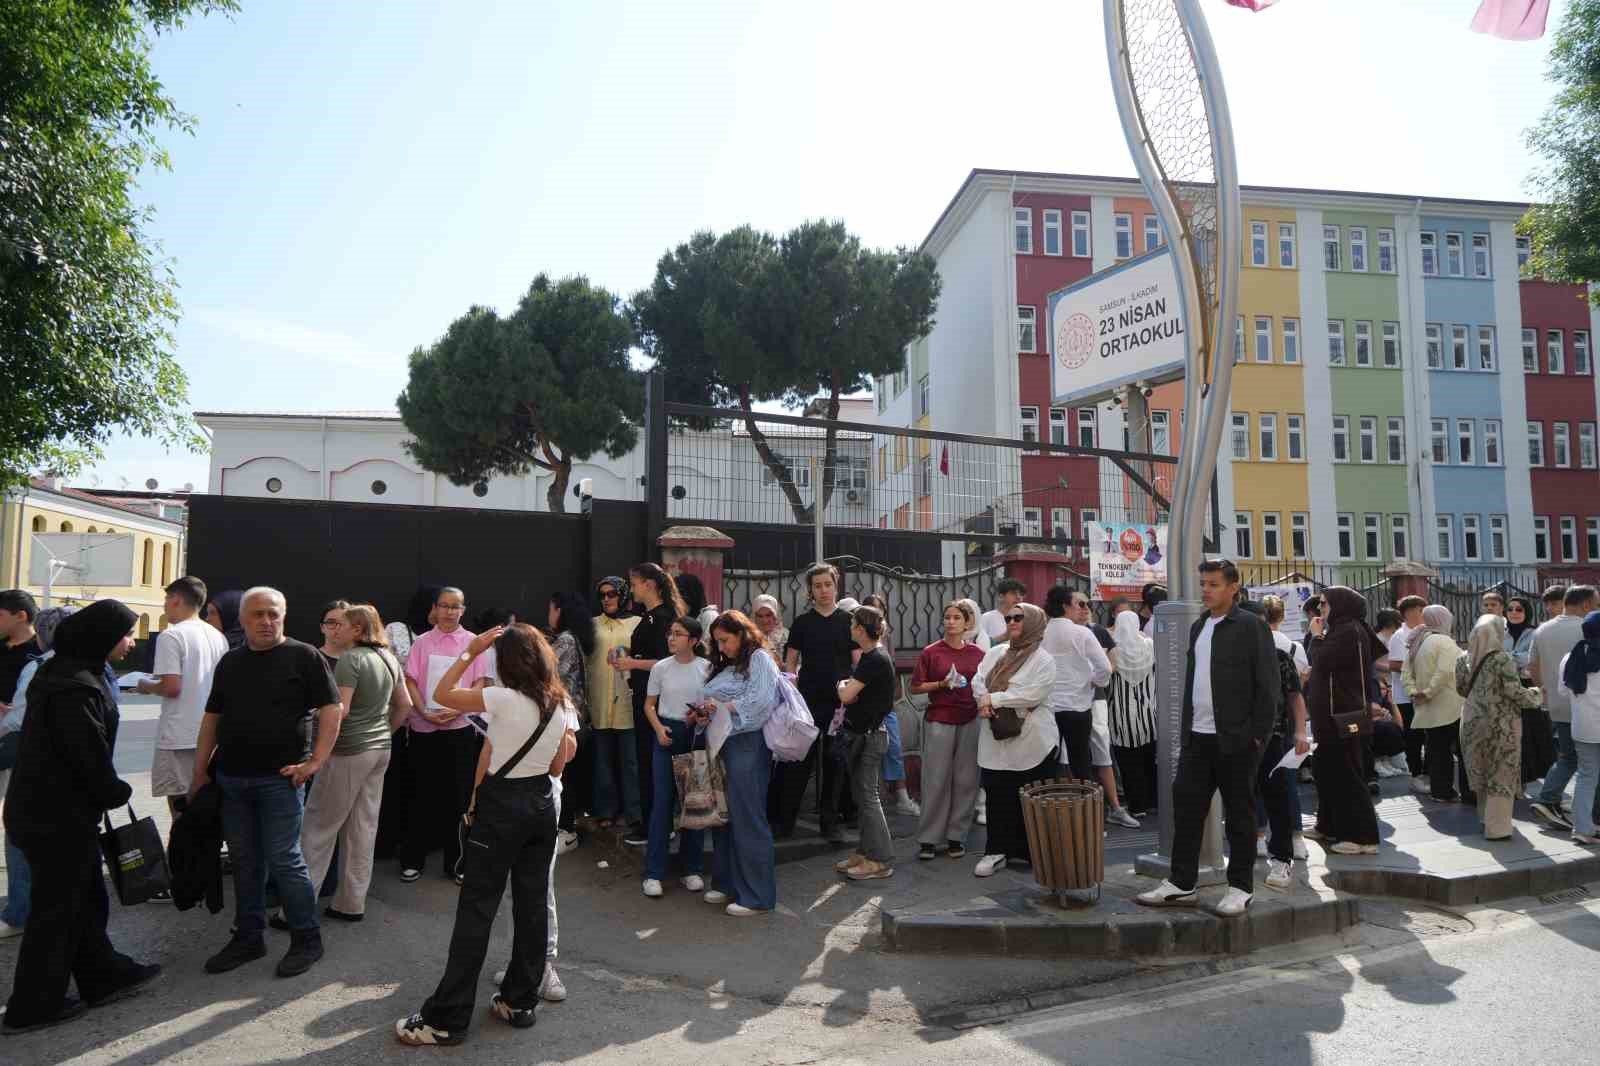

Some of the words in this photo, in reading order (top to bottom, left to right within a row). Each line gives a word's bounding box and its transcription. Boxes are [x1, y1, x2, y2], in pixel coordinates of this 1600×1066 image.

[1099, 297, 1126, 314] SAMSUN
[1099, 317, 1115, 336] 23
[1119, 297, 1166, 329] NİSAN
